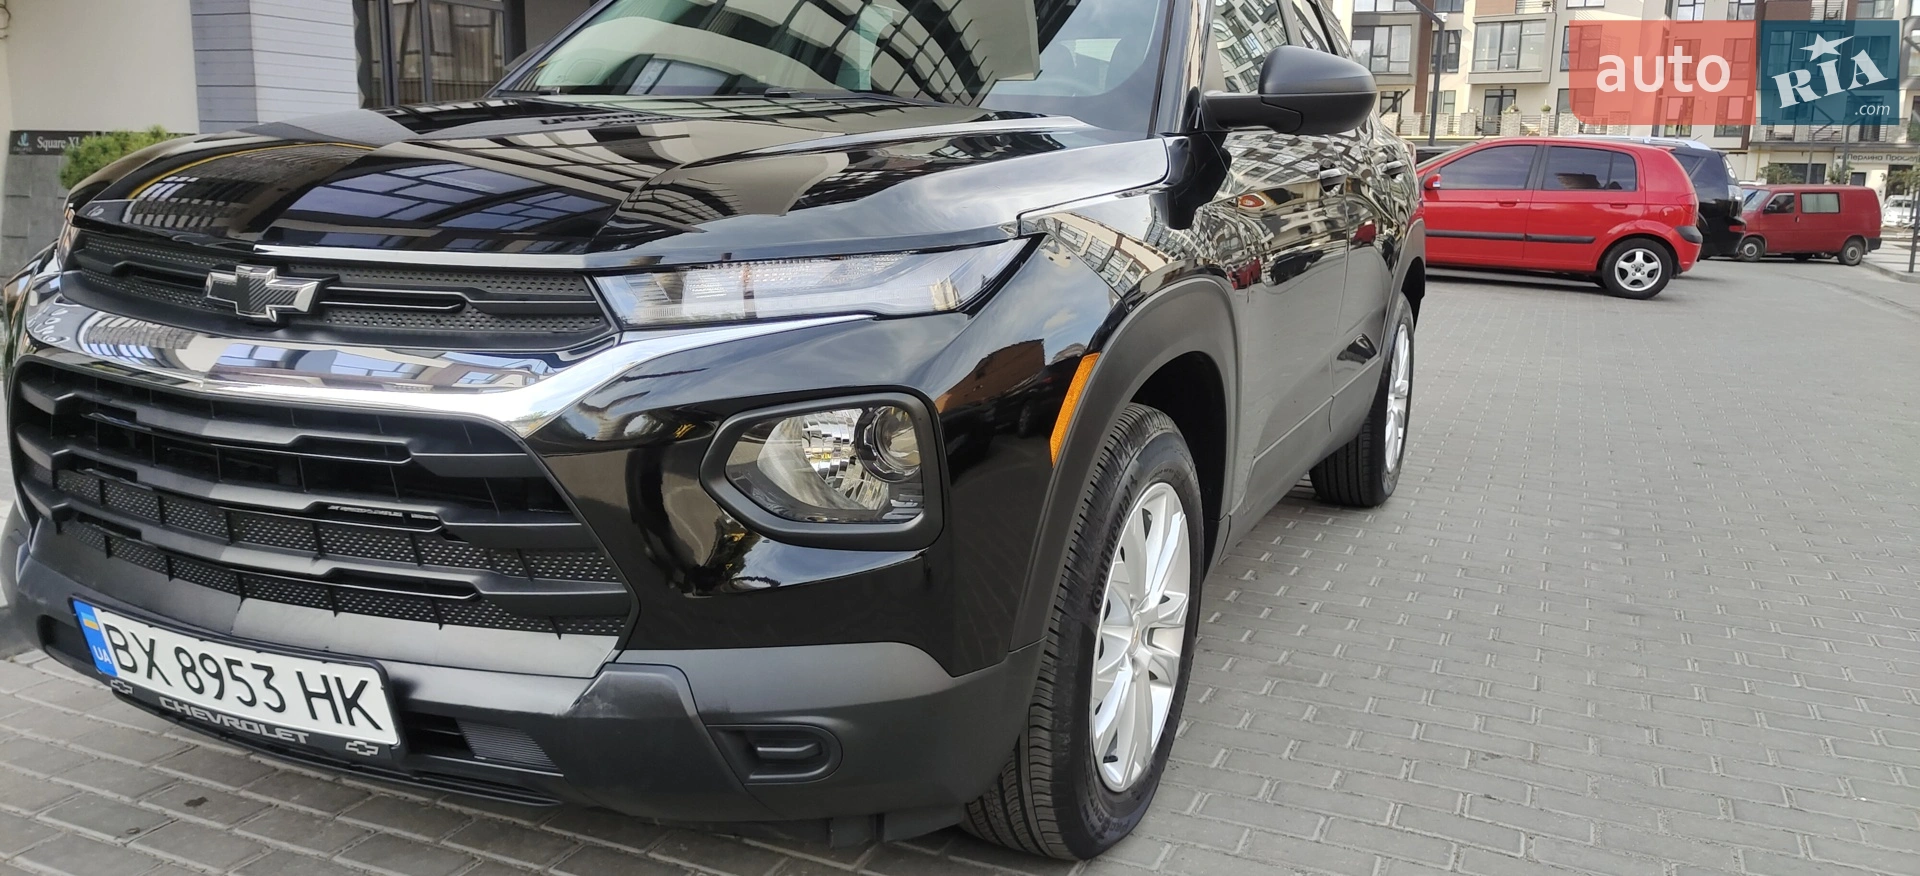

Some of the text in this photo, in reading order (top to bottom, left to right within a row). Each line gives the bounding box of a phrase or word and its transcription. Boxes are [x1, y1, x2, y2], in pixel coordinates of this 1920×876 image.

[37, 136, 66, 152] Square
[92, 645, 113, 665] UA
[103, 622, 384, 731] BX 8953 HK
[159, 696, 310, 744] CHEVROLET
